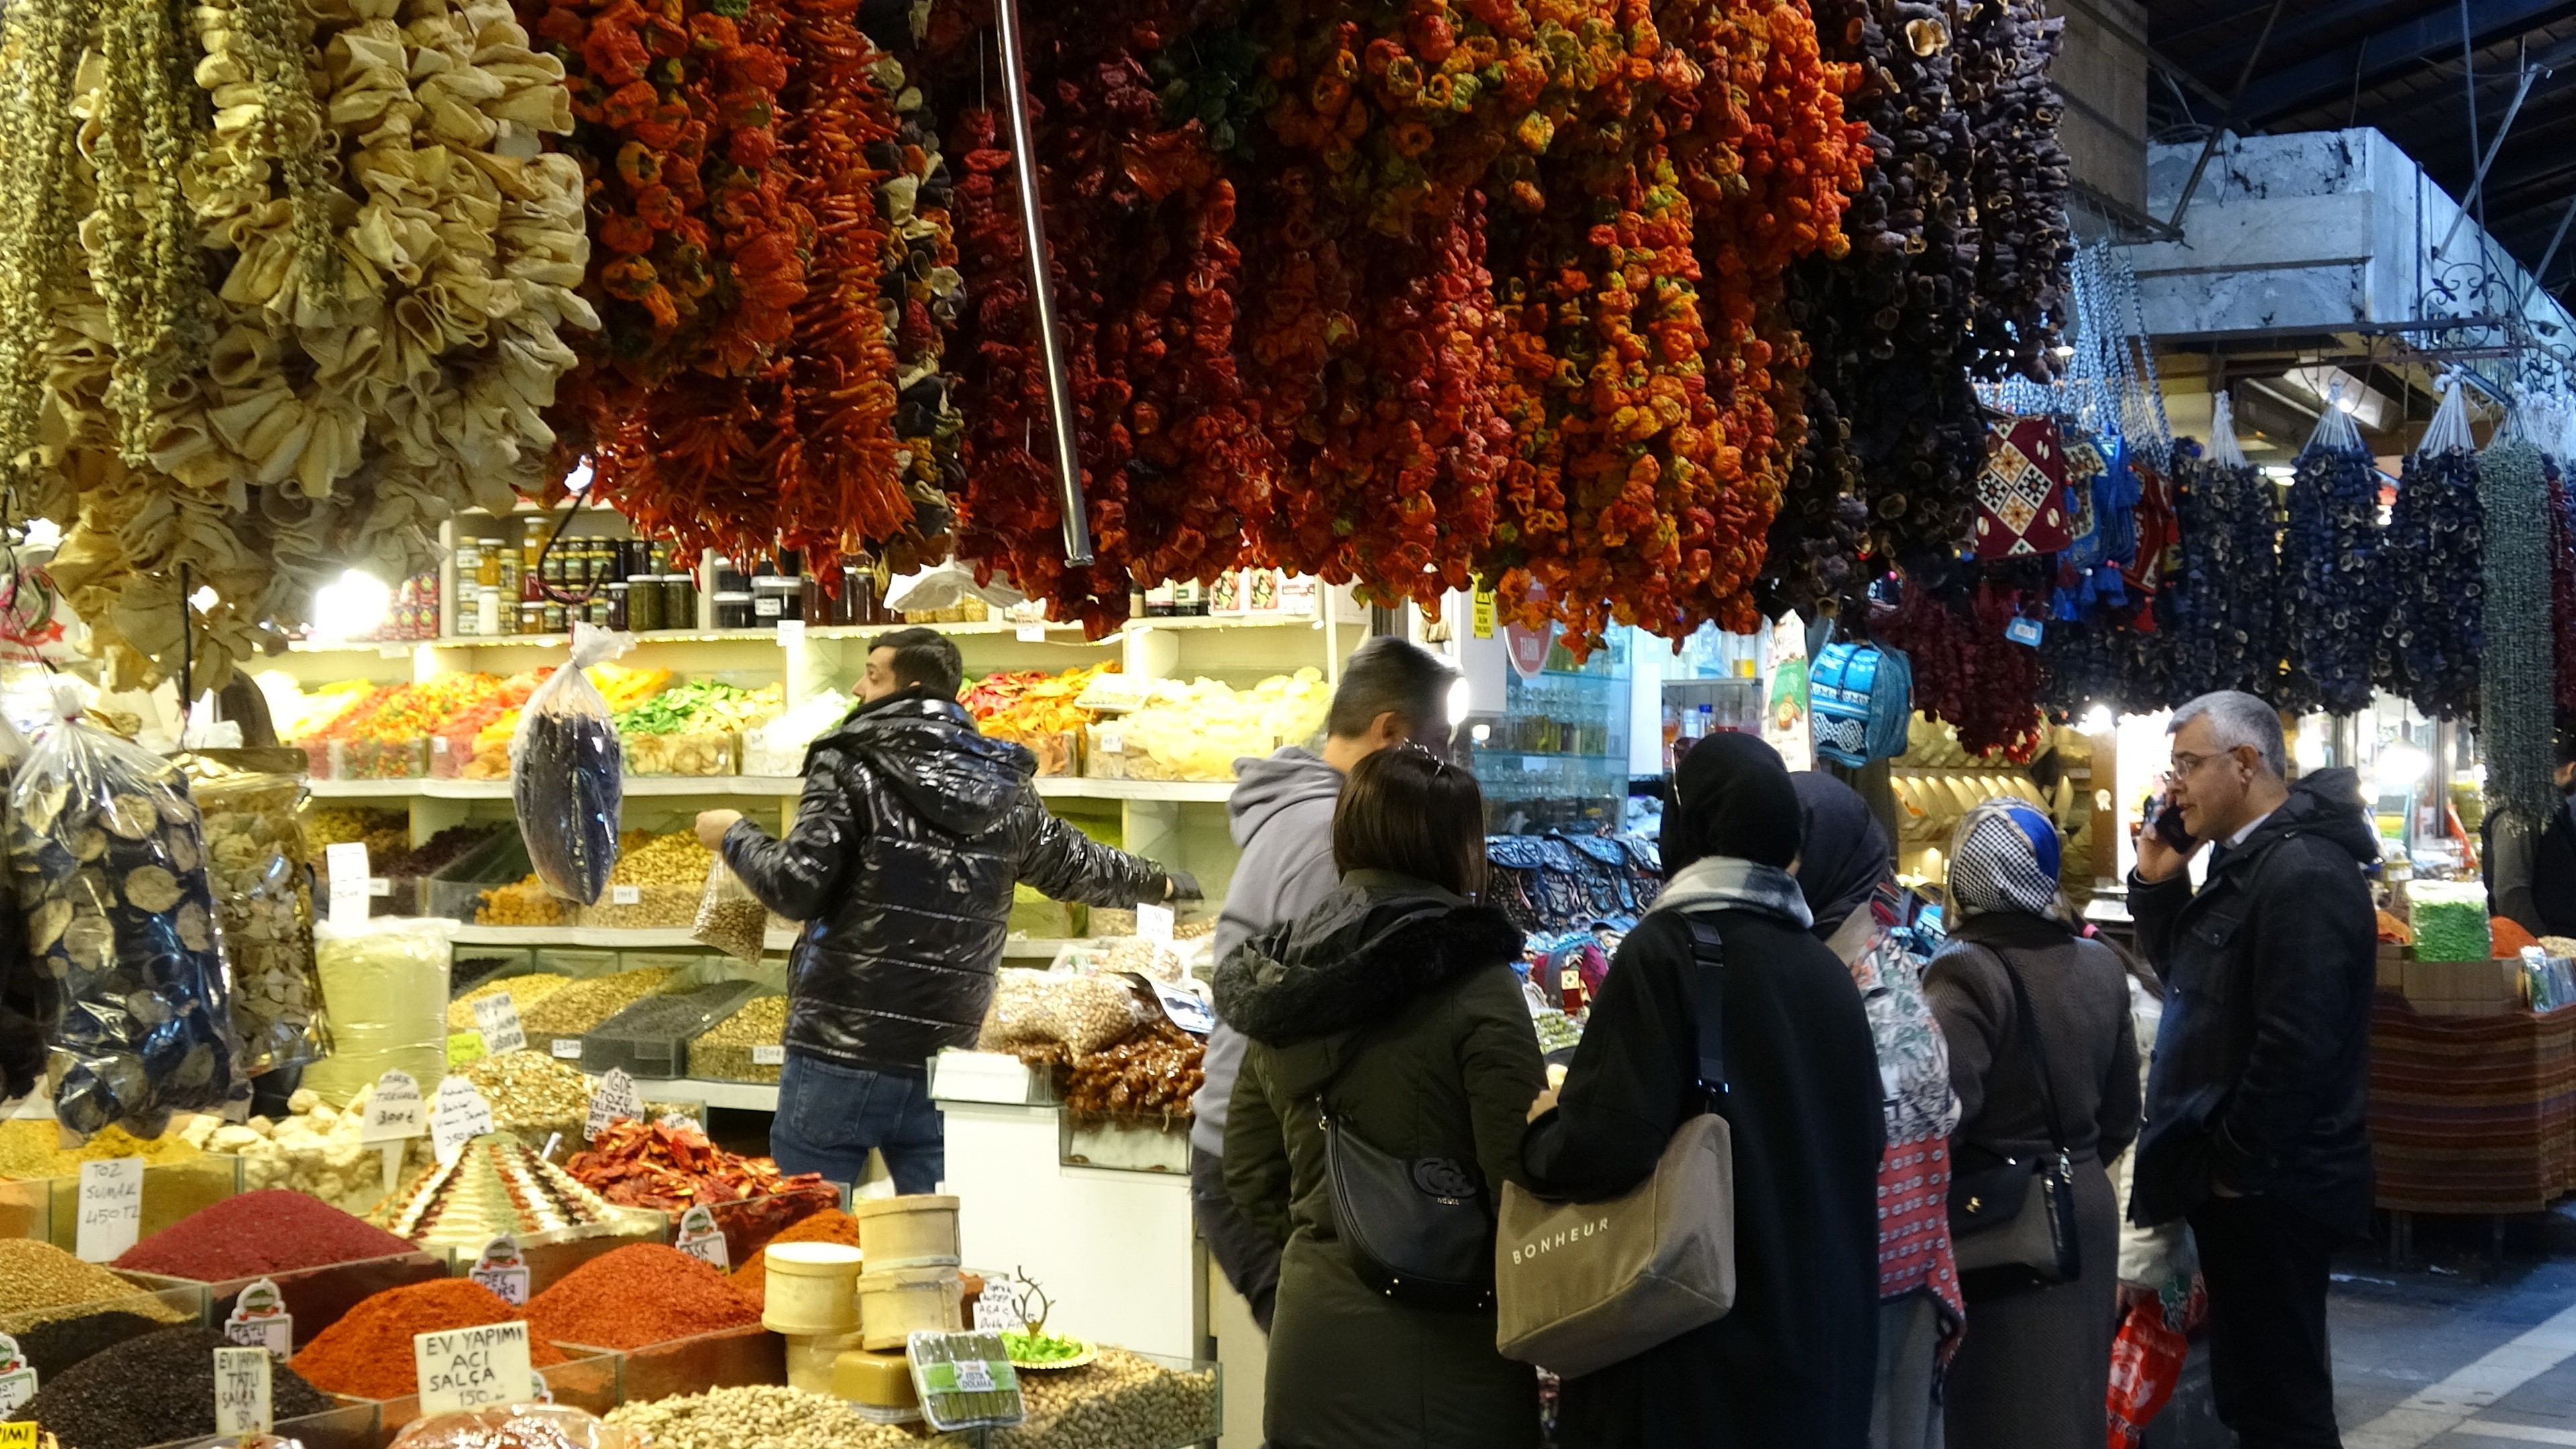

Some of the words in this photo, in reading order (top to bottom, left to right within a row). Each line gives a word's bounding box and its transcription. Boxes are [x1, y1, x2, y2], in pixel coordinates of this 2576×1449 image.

[1513, 1217, 1608, 1265] BONHEUR
[427, 1335, 453, 1356] EV
[462, 1327, 523, 1350] YAPIMI
[451, 1350, 488, 1371] ACI
[429, 1367, 496, 1392] SALÇA
